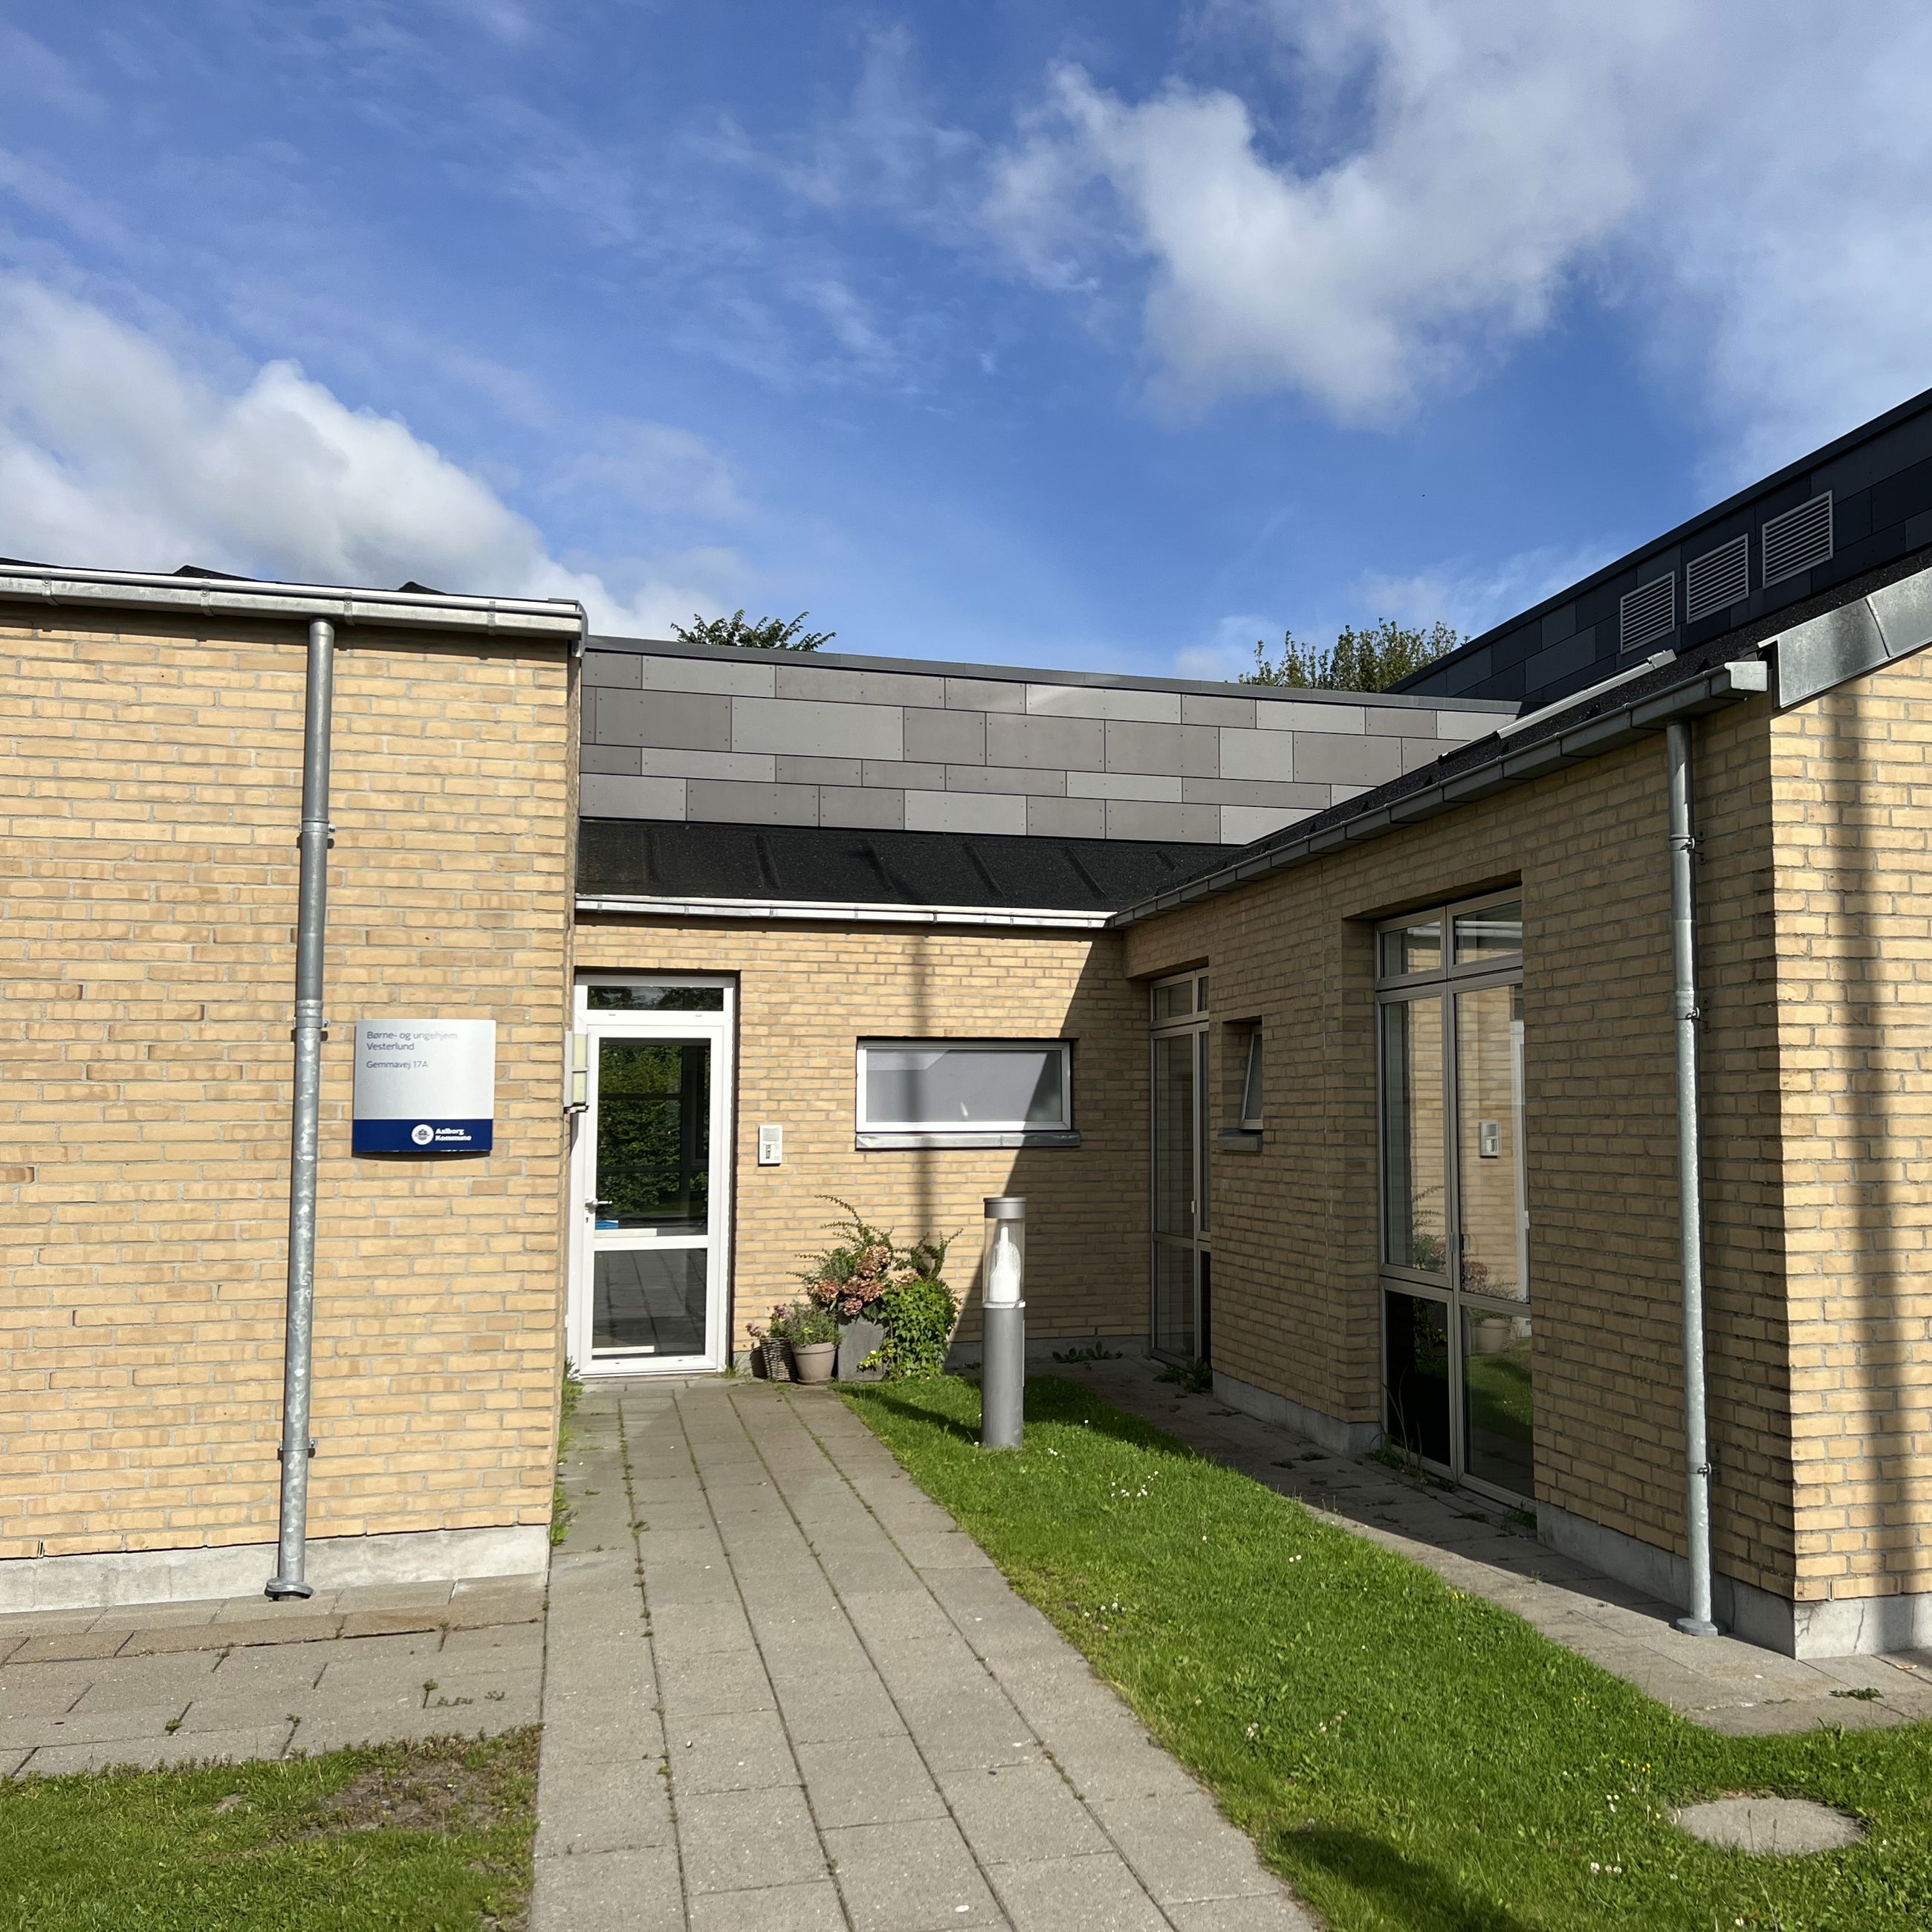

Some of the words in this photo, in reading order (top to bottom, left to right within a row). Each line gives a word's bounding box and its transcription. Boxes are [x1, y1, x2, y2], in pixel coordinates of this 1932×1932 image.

[366, 1031, 397, 1040] Børne-
[400, 1032, 411, 1041] og
[413, 1031, 458, 1041] ungehjem
[366, 1043, 415, 1051] Vesterlund
[366, 1060, 411, 1069] Gemmavej
